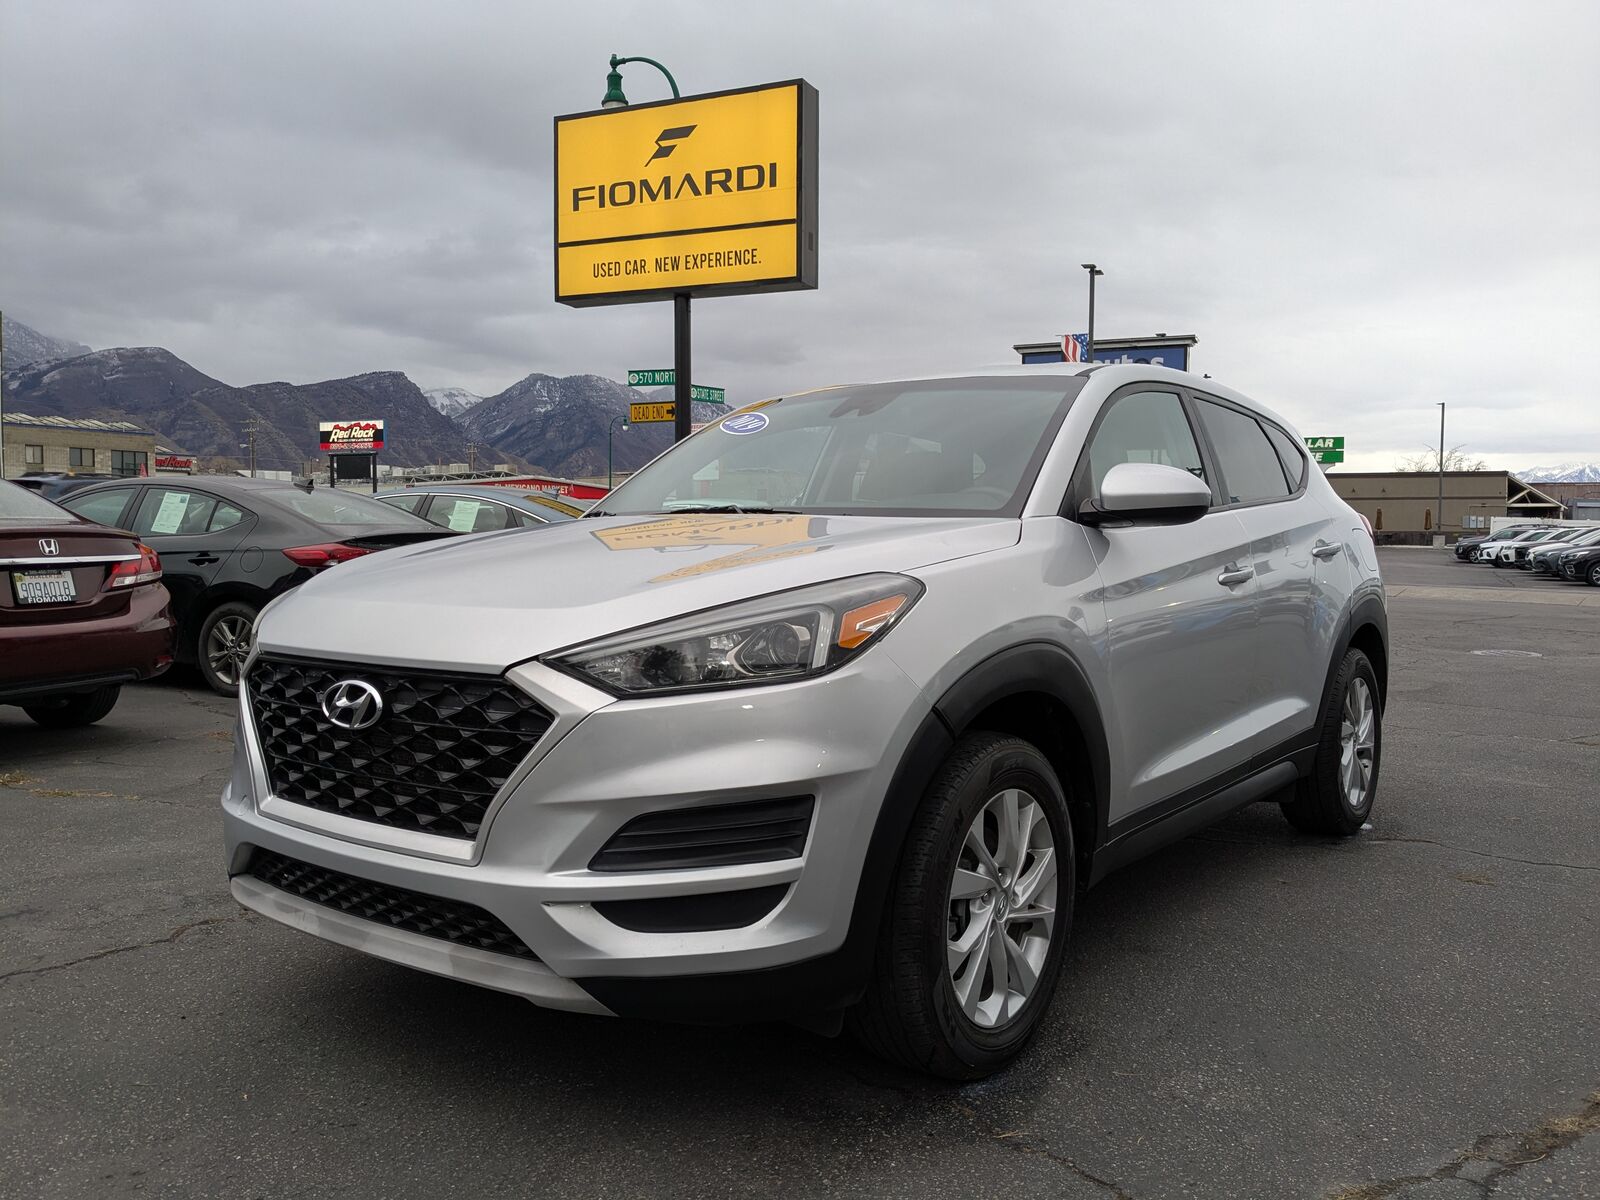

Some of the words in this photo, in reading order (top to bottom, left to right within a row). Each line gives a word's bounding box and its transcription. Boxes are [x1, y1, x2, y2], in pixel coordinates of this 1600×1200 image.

[572, 162, 777, 212] FIOMARDI
[593, 261, 621, 279] USED
[625, 258, 650, 276] CAR.
[655, 255, 681, 273] NEW
[685, 248, 762, 270] EXPERIENCE.
[639, 372, 653, 384] 570
[655, 371, 675, 383] NORT
[696, 387, 709, 400] STATE
[710, 389, 724, 402] STREET
[634, 406, 649, 420] DEAD
[653, 405, 665, 419] END
[329, 428, 351, 443] Red
[350, 426, 376, 438] Rock
[27, 595, 72, 604] FIOMARDI
